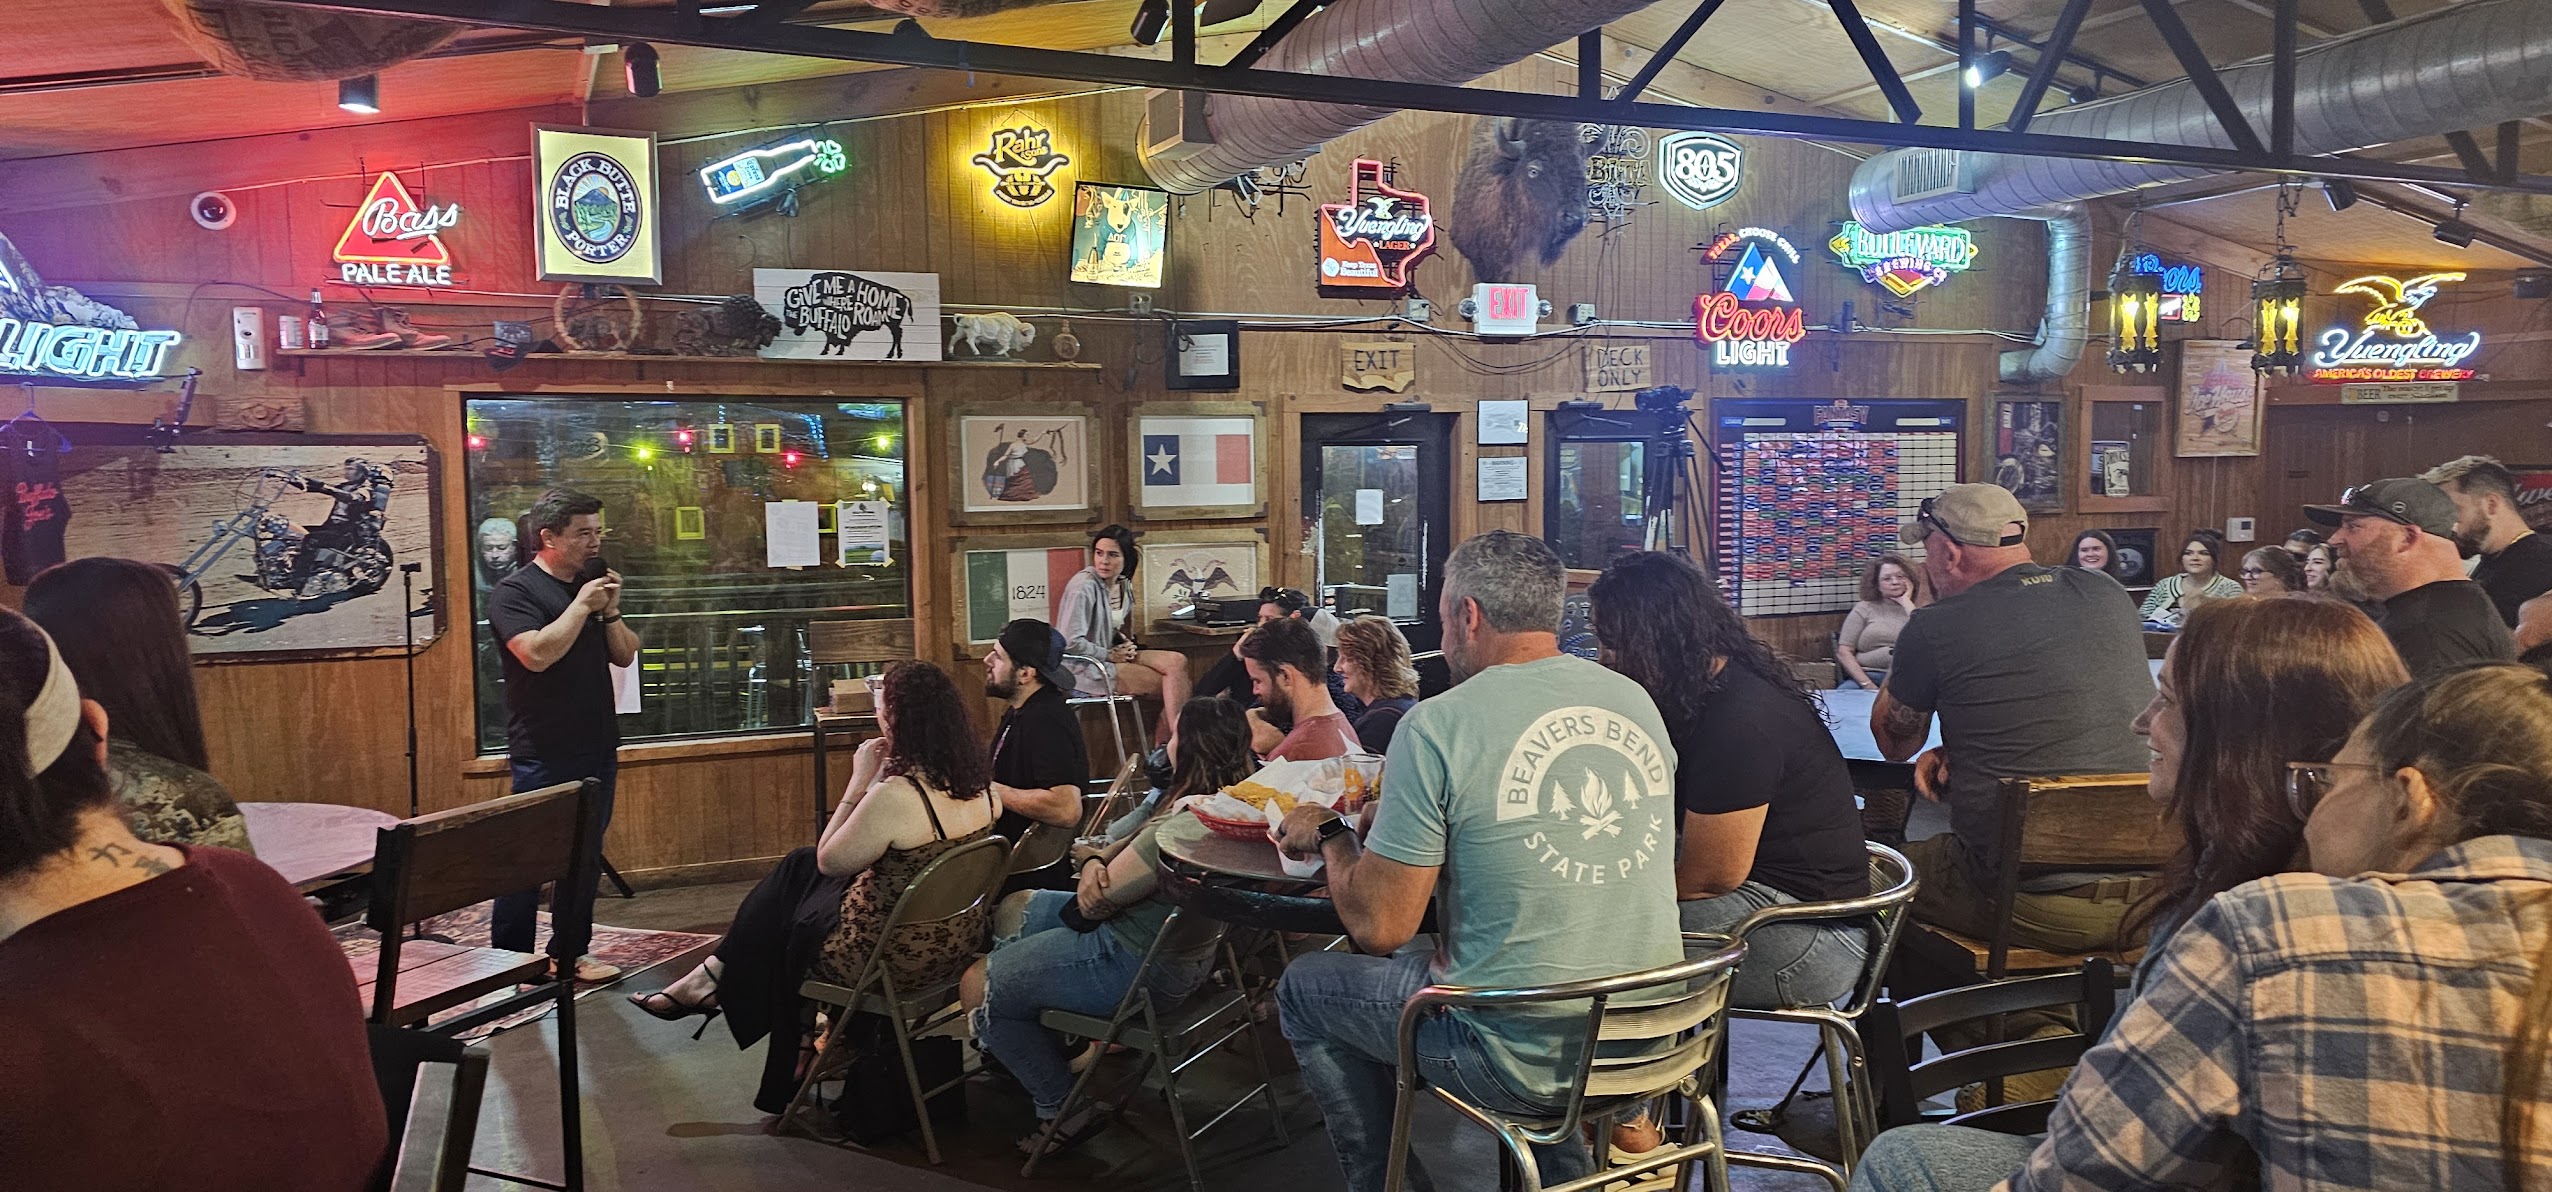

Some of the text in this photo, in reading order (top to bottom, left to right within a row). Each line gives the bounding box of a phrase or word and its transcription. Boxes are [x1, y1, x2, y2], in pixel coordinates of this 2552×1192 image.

[993, 129, 1047, 166] Rahr
[1675, 148, 1736, 182] 805
[555, 158, 637, 214] BLACK BUTTE
[362, 197, 460, 237] Bass
[1337, 206, 1432, 242] Yuengling
[1380, 241, 1410, 251] LAGER
[1738, 226, 1779, 242] CHOOSE
[341, 262, 452, 286] PALE ALE
[822, 295, 854, 312] WHERE
[823, 276, 846, 295] ME
[847, 279, 856, 294] A
[857, 281, 904, 320] HOME
[1489, 286, 1530, 320] EXIT
[798, 306, 852, 340] BUFFALO
[852, 301, 890, 327] ROAM
[1700, 292, 1806, 344] Coors
[1354, 349, 1400, 372] EXIT
[1597, 348, 1643, 367] DECK
[1715, 340, 1792, 366] LIGHT
[2314, 329, 2481, 368] Yuengling
[1597, 370, 1642, 387] ONLY
[2313, 367, 2475, 381] AMERICA'S OLDEST BREWERY
[2357, 388, 2381, 400] BEER
[1814, 405, 1870, 426] FANTASY
[1012, 585, 1046, 600] 1824
[2020, 574, 2054, 587] KUIU
[1507, 714, 1663, 805] BEAVERS BEND
[1524, 813, 1662, 885] STATE PARK
